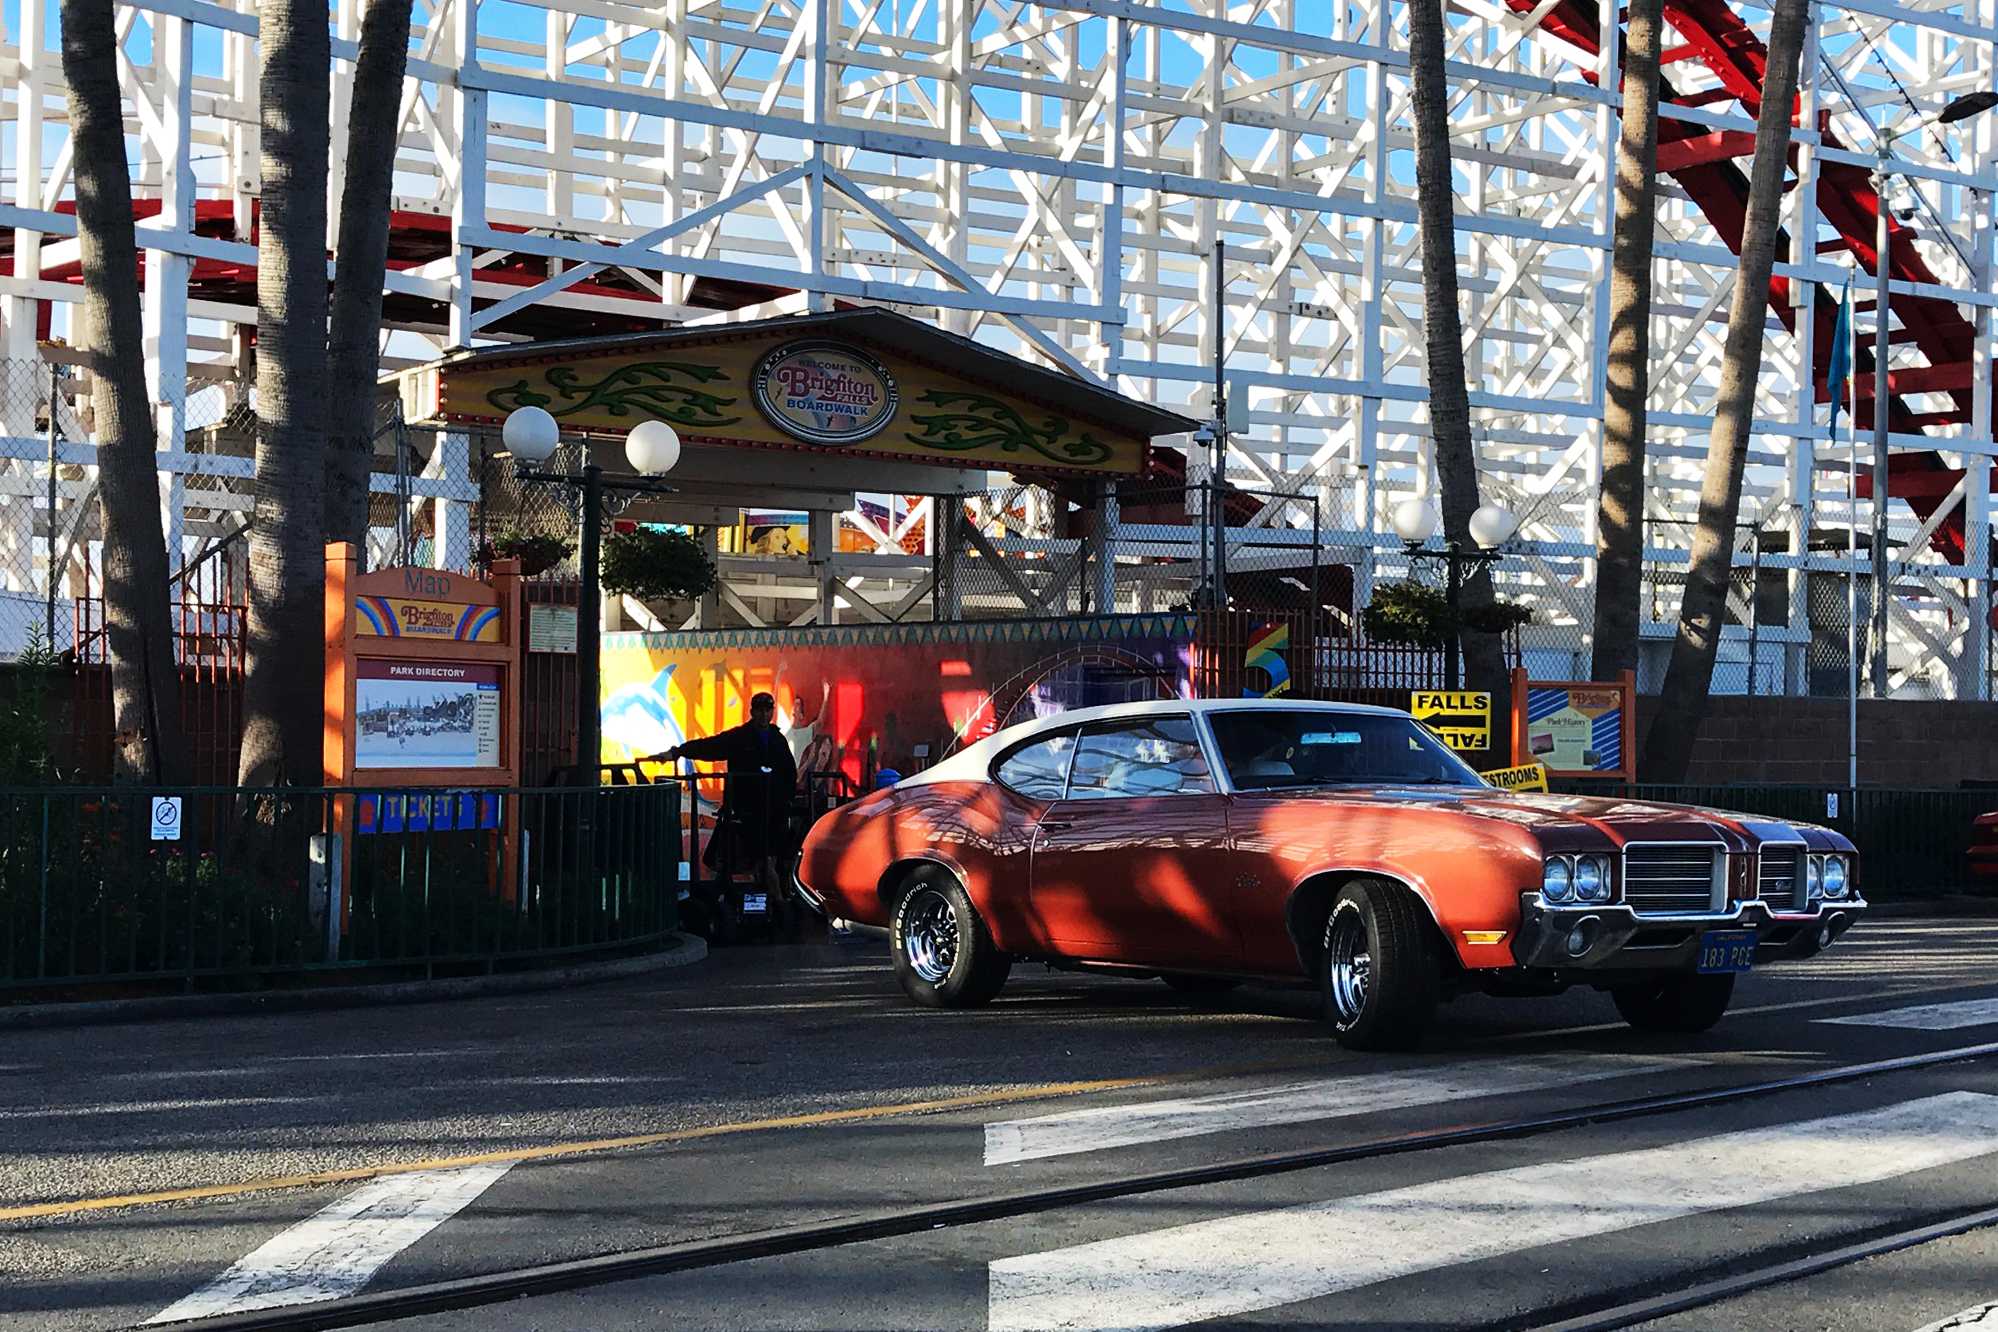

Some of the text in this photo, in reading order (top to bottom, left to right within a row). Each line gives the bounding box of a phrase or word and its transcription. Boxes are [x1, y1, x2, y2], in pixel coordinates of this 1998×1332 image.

[799, 359, 862, 374] WELCOME TO
[777, 367, 878, 404] Brighton
[787, 399, 868, 416] BOARDWALK
[837, 393, 869, 406] FALLS
[404, 570, 450, 599] Map
[401, 606, 455, 626] Brighton
[390, 666, 465, 677] PARK DIRECTORY
[1417, 695, 1488, 710] FALLS
[1436, 733, 1487, 748] FAL
[1481, 766, 1540, 788] STROOMS
[1701, 947, 1726, 969] 183
